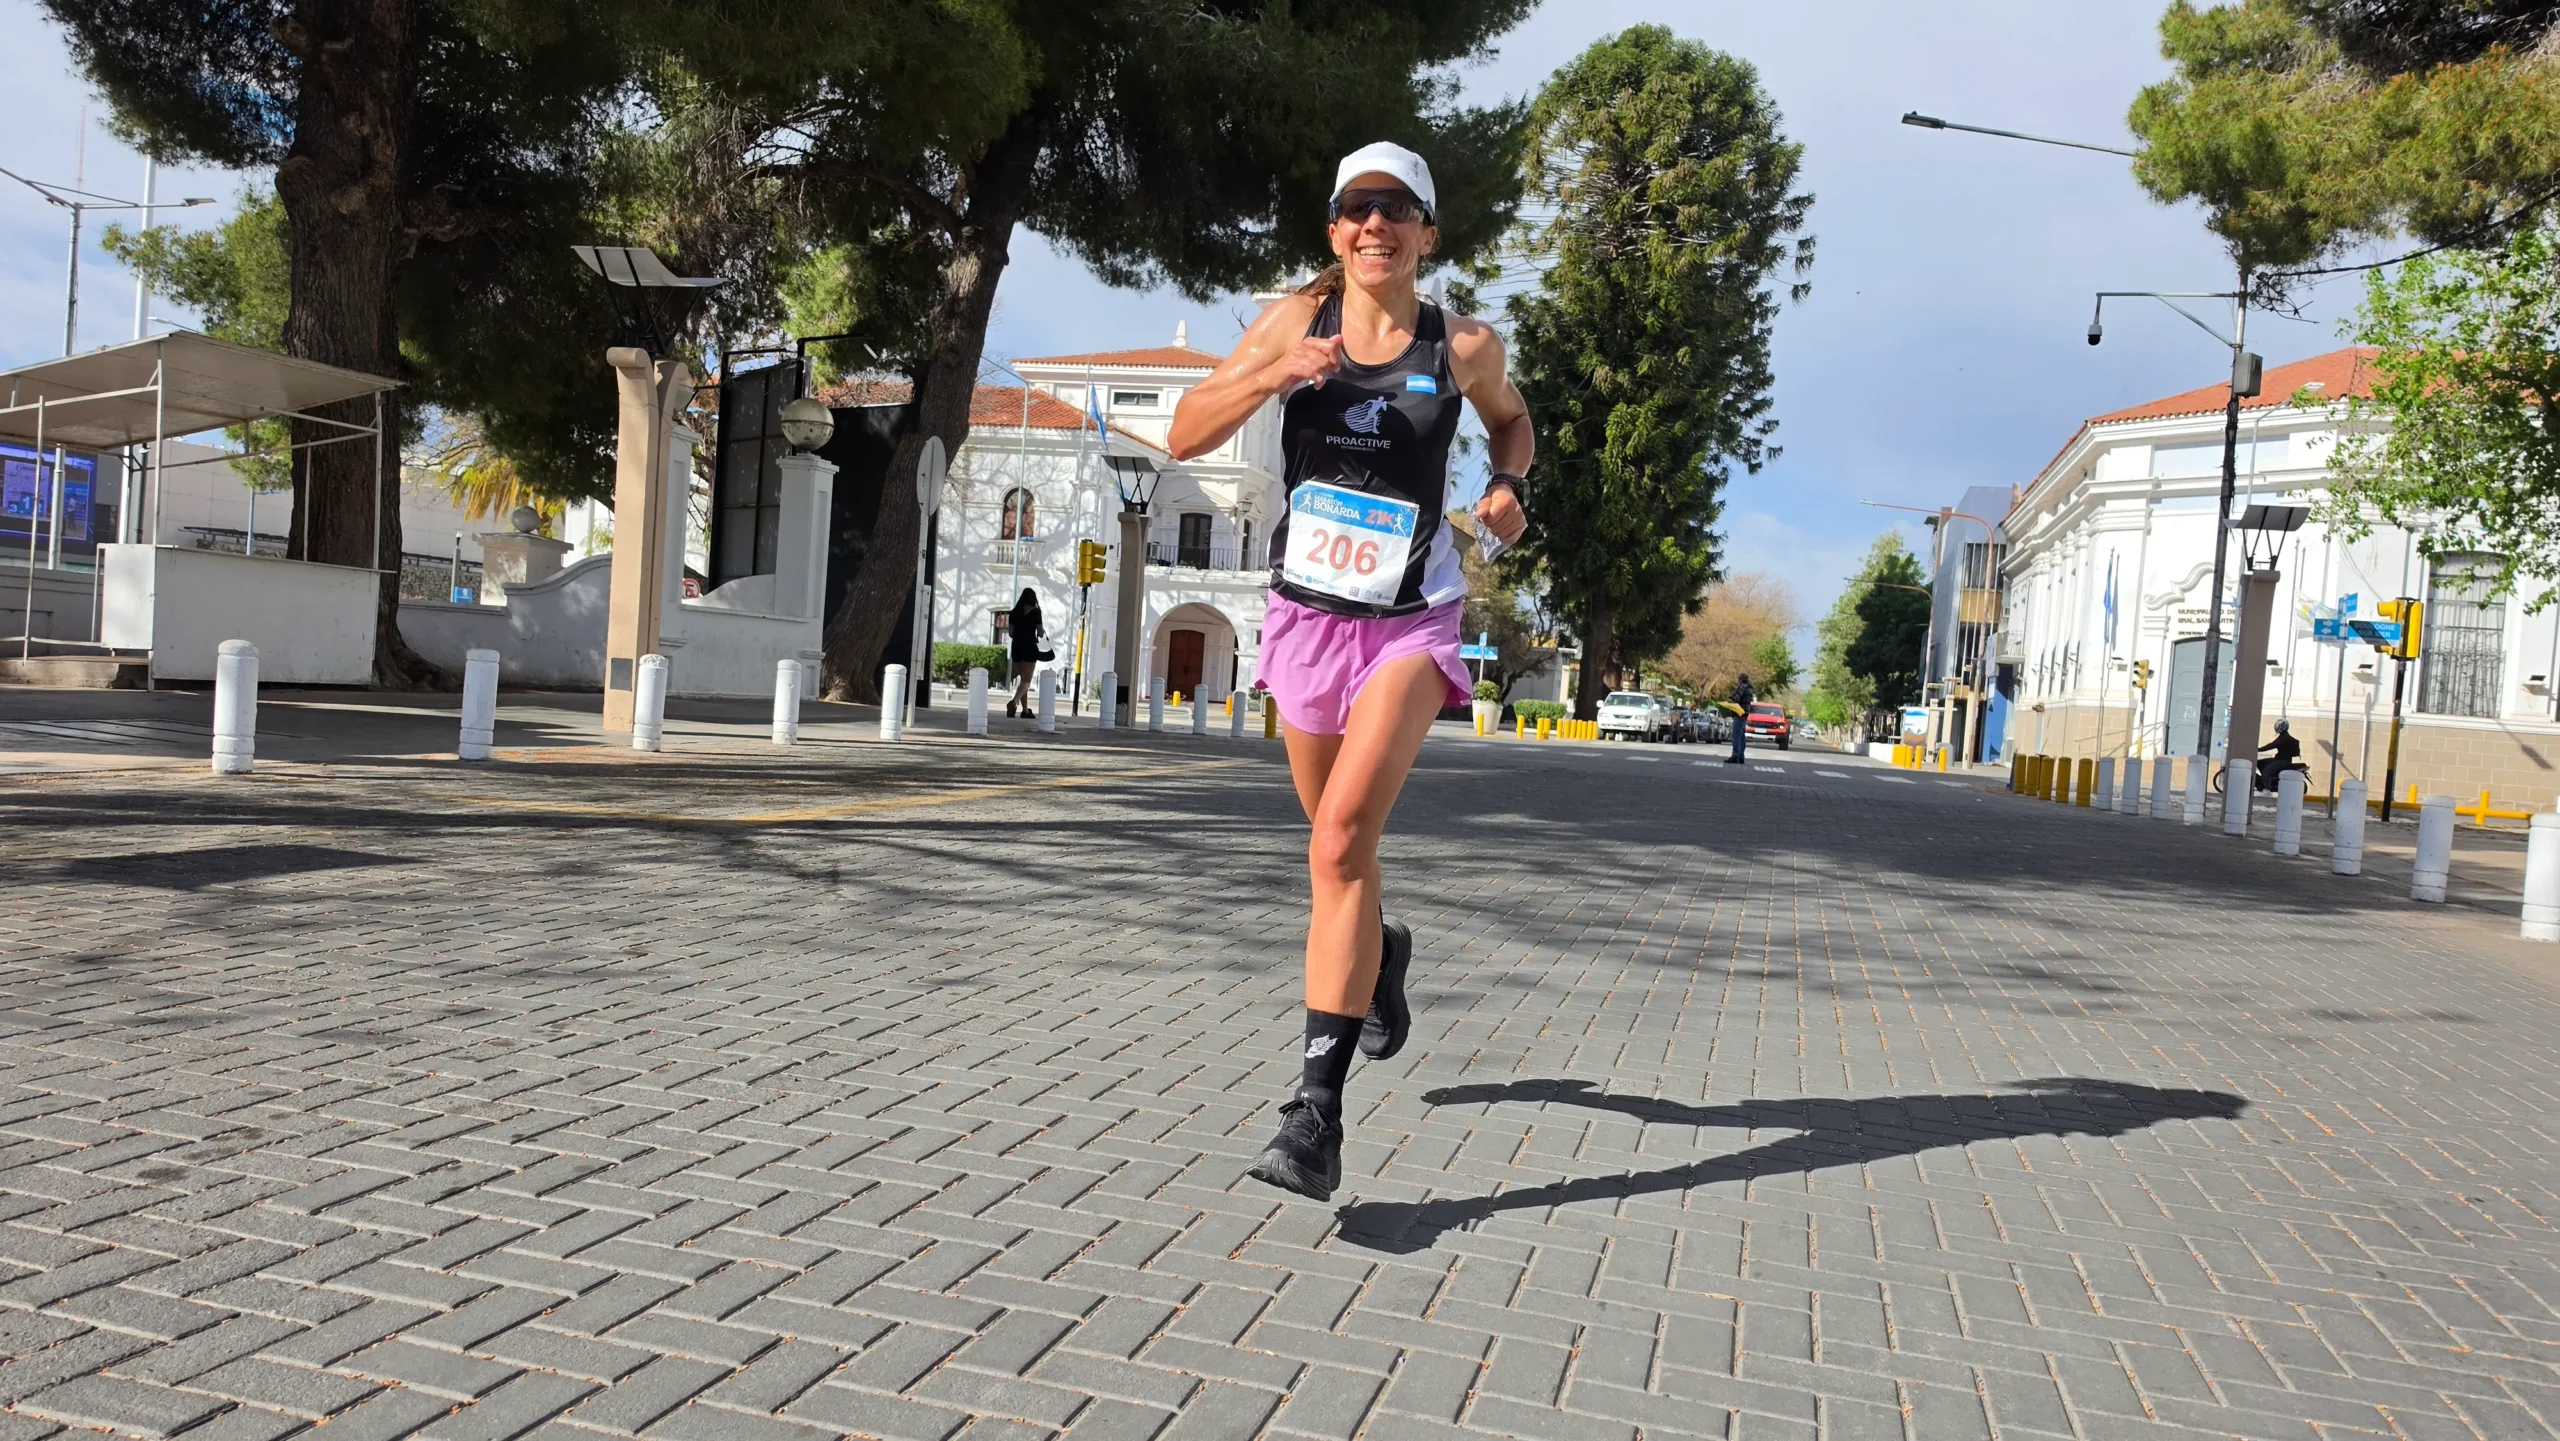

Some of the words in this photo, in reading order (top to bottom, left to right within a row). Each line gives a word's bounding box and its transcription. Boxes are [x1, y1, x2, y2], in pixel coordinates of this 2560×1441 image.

[1326, 435, 1391, 449] PROACTIVE
[1314, 495, 1344, 506] MARATÓN
[1313, 500, 1361, 520] BONARDA
[1365, 509, 1395, 528] 21K
[1306, 528, 1380, 576] 206
[2354, 622, 2396, 631] BOULOGNE
